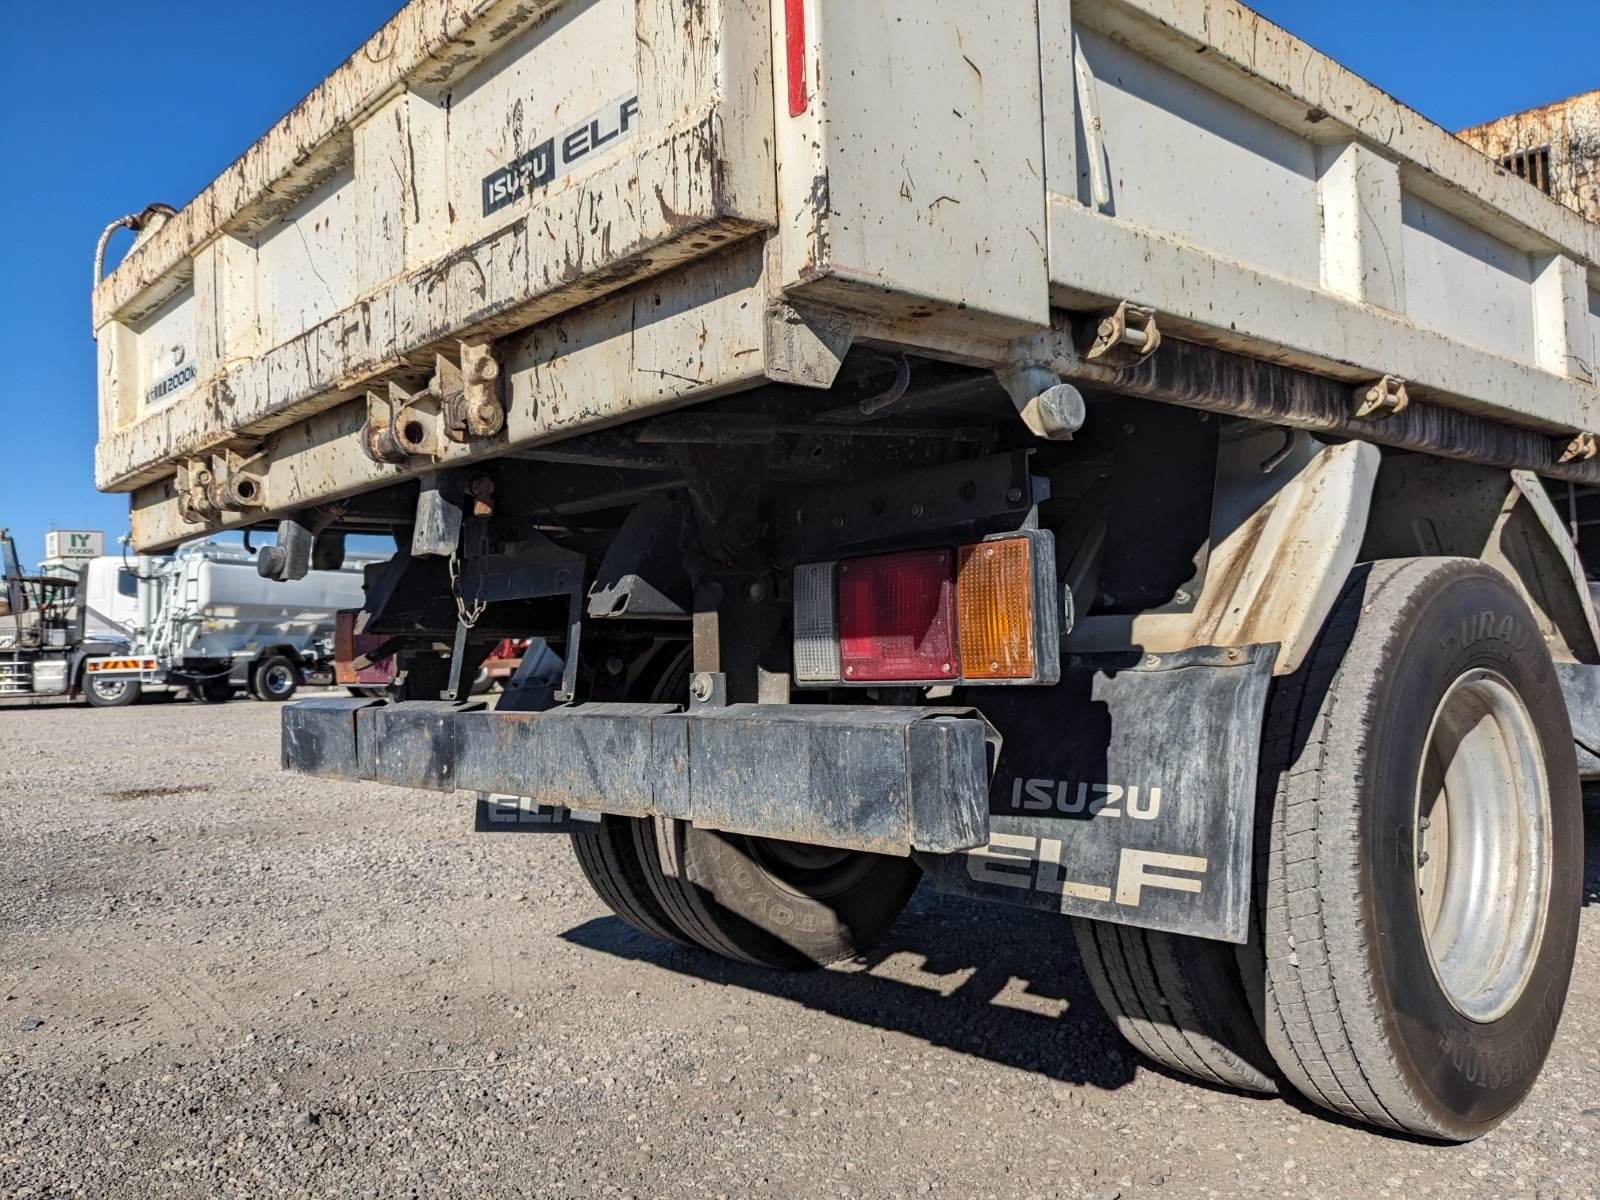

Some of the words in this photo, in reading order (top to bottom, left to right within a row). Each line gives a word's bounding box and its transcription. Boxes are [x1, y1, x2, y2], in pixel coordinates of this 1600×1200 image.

[489, 153, 547, 204] ISUZU
[562, 95, 638, 165] ELF
[71, 534, 91, 547] IY
[1011, 777, 1161, 820] ISUZU
[966, 832, 1208, 907] ELF
